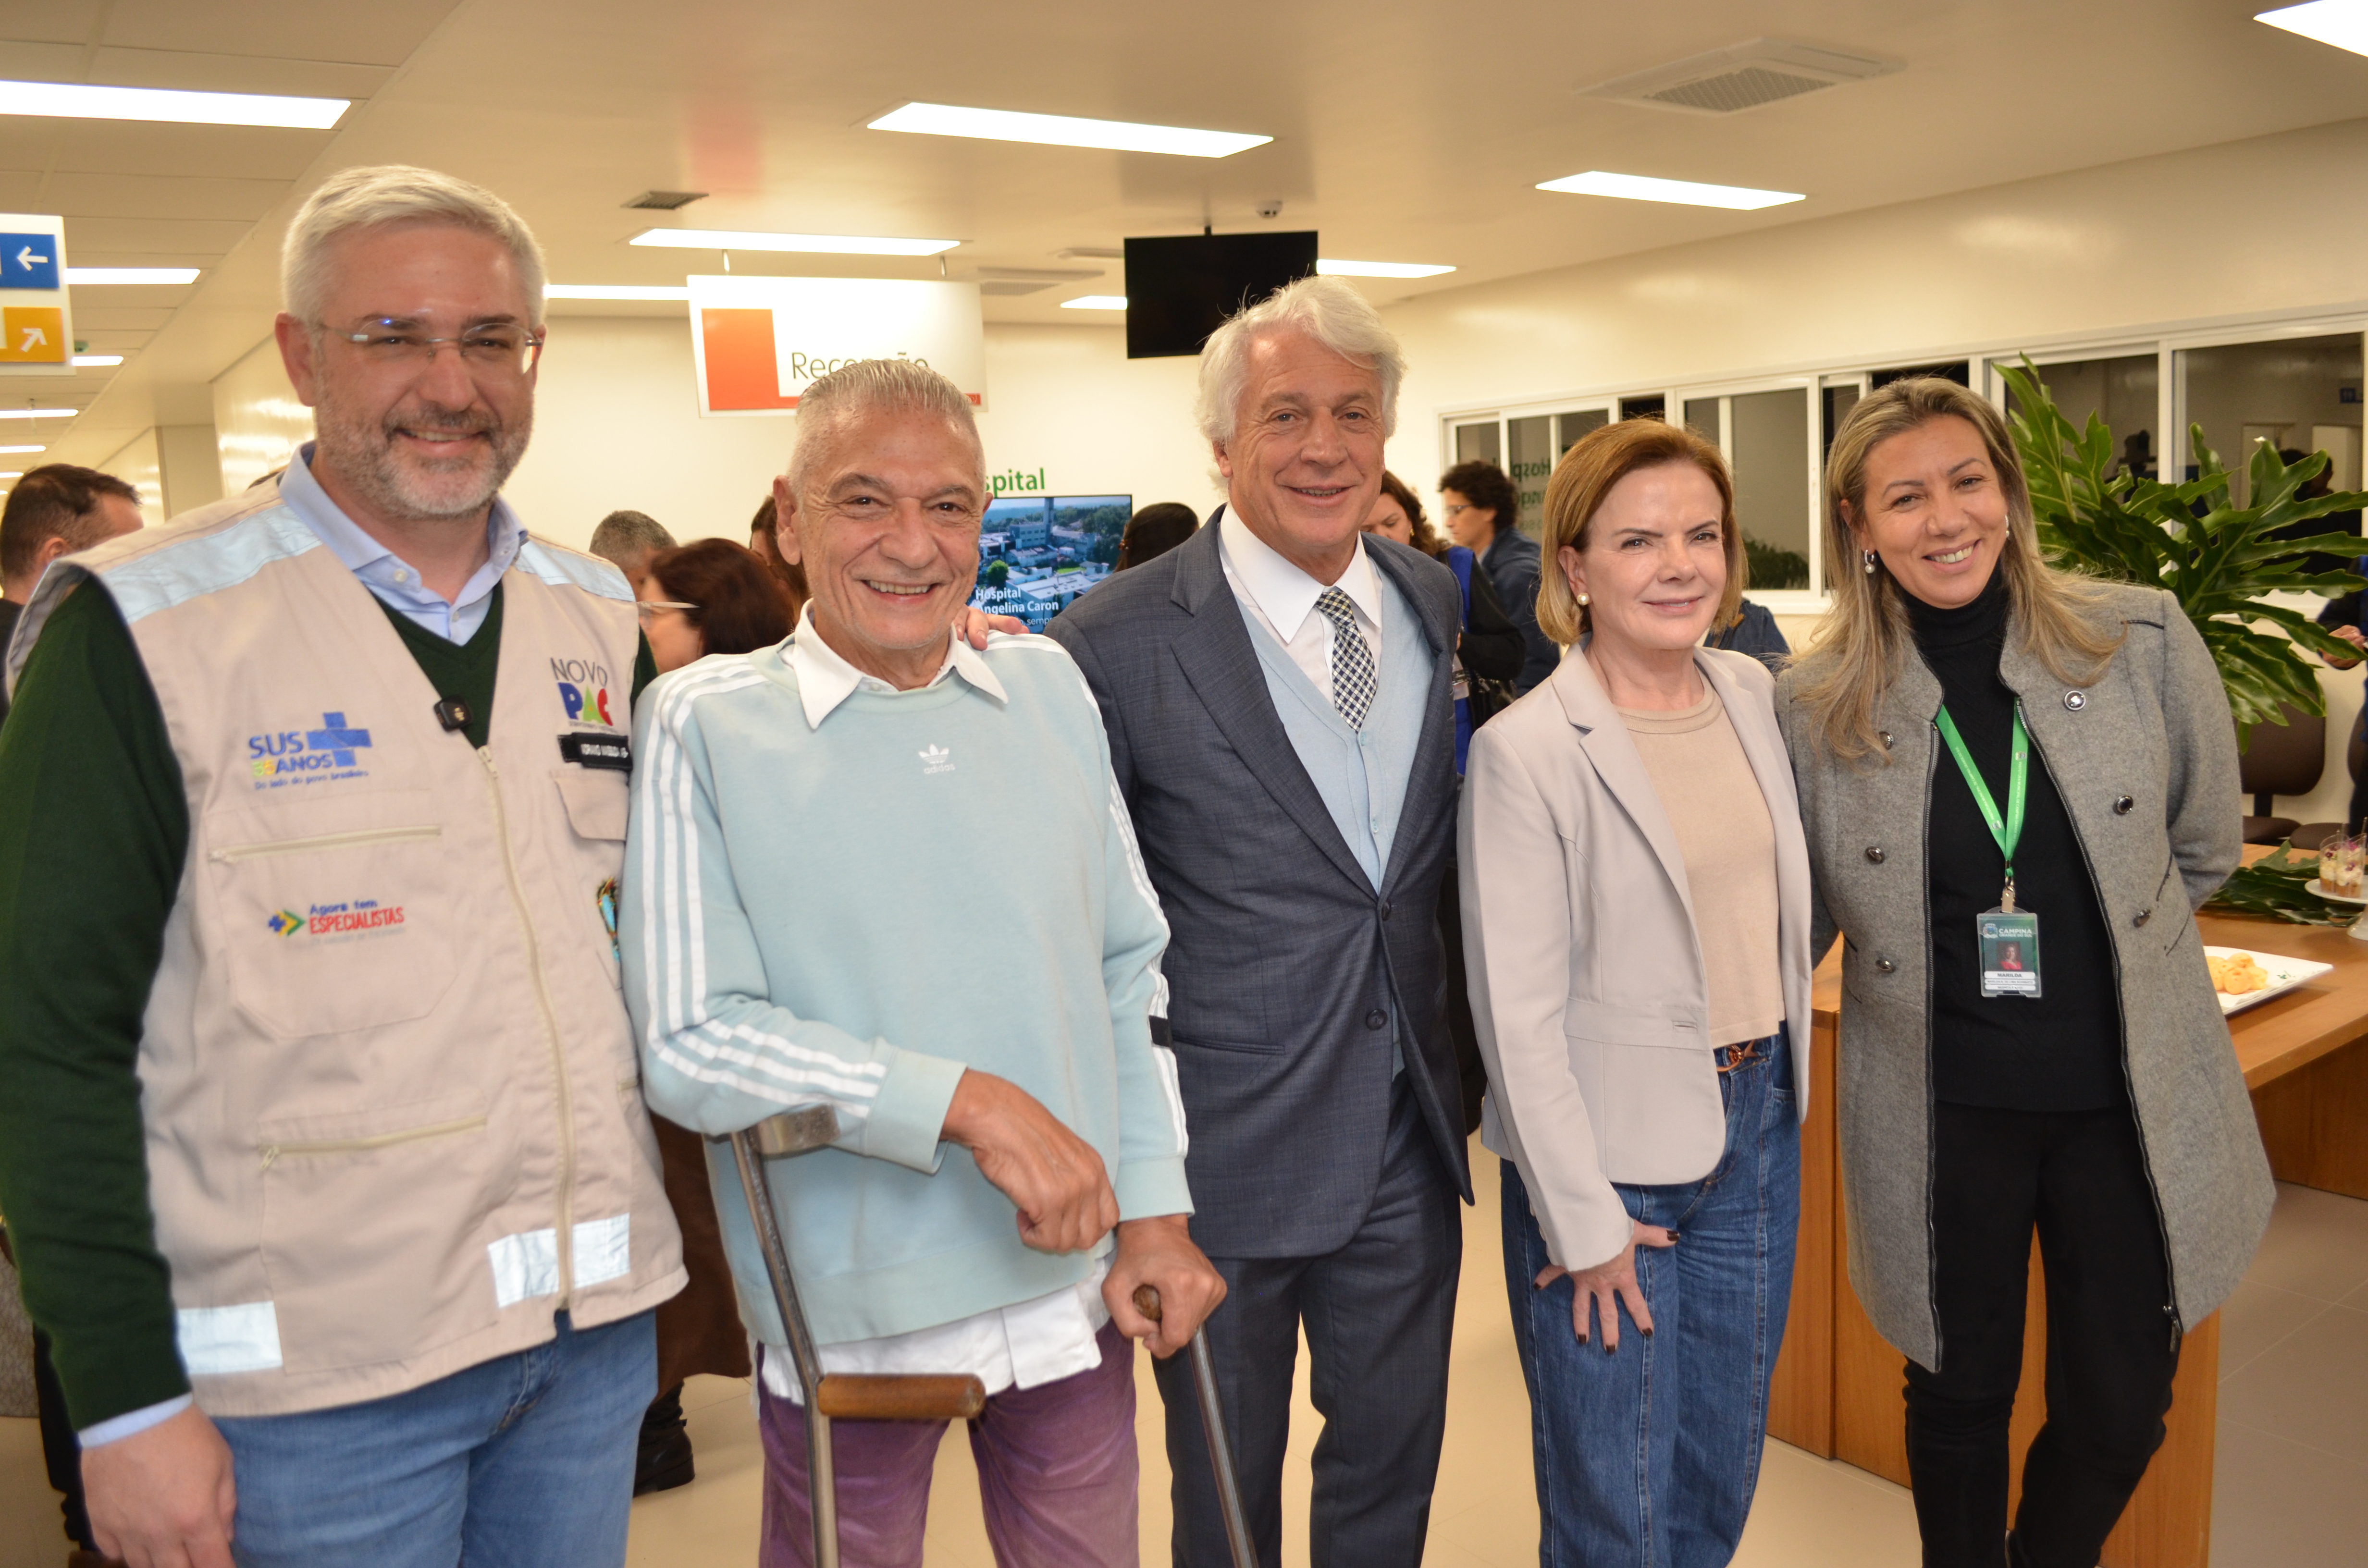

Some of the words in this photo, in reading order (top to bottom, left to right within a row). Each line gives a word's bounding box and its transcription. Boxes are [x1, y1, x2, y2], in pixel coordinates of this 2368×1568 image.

[975, 587, 1021, 602] Hospital
[1027, 600, 1059, 612] Caron
[550, 657, 608, 688] NOVO
[557, 682, 614, 726] PAC
[248, 731, 304, 760] SUS
[275, 753, 333, 774] ANOS
[309, 906, 405, 934] ESPECIALISTAS
